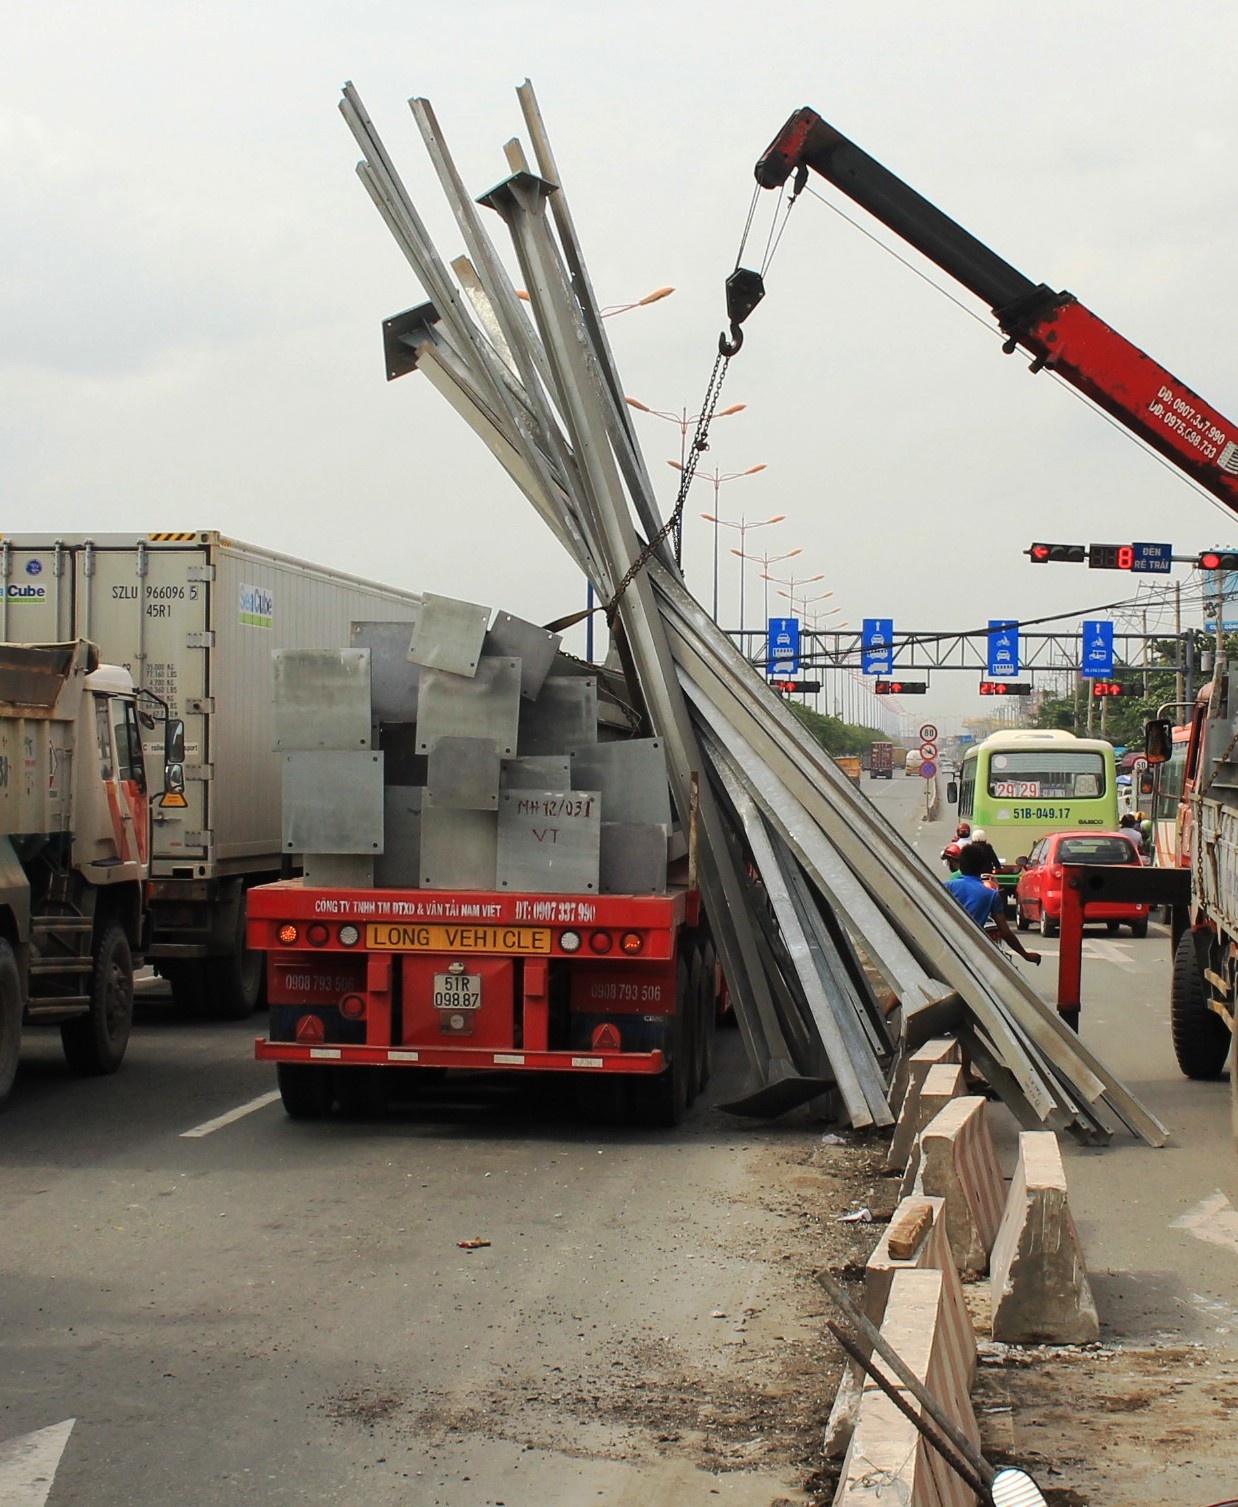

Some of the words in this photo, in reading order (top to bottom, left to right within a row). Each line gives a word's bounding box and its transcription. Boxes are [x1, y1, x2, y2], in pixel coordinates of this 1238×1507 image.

[112, 586, 138, 599] SZLU
[146, 586, 185, 599] 966096
[190, 586, 198, 600] 5
[146, 604, 171, 617] 45R1
[924, 729, 934, 737] 80
[1135, 760, 1147, 770] 50
[997, 783, 1015, 797] 29
[1020, 783, 1037, 798] 29
[1013, 808, 1071, 819] 51B-049.17
[532, 828, 560, 844] VT
[339, 900, 351, 914] TY
[352, 901, 376, 914] TNHH
[377, 902, 391, 915] TM
[417, 903, 424, 915] &
[460, 904, 480, 918] NAM
[533, 902, 558, 922] 0907
[558, 902, 577, 922] 337
[578, 903, 596, 923] 990
[373, 926, 430, 947] LONG
[445, 928, 545, 950] VEHICLE
[285, 974, 310, 991] 0908
[312, 975, 332, 991] 793
[444, 976, 470, 991] 51R
[434, 992, 479, 1008] 098.87
[618, 984, 639, 1000] 793
[640, 985, 661, 1001] 506
